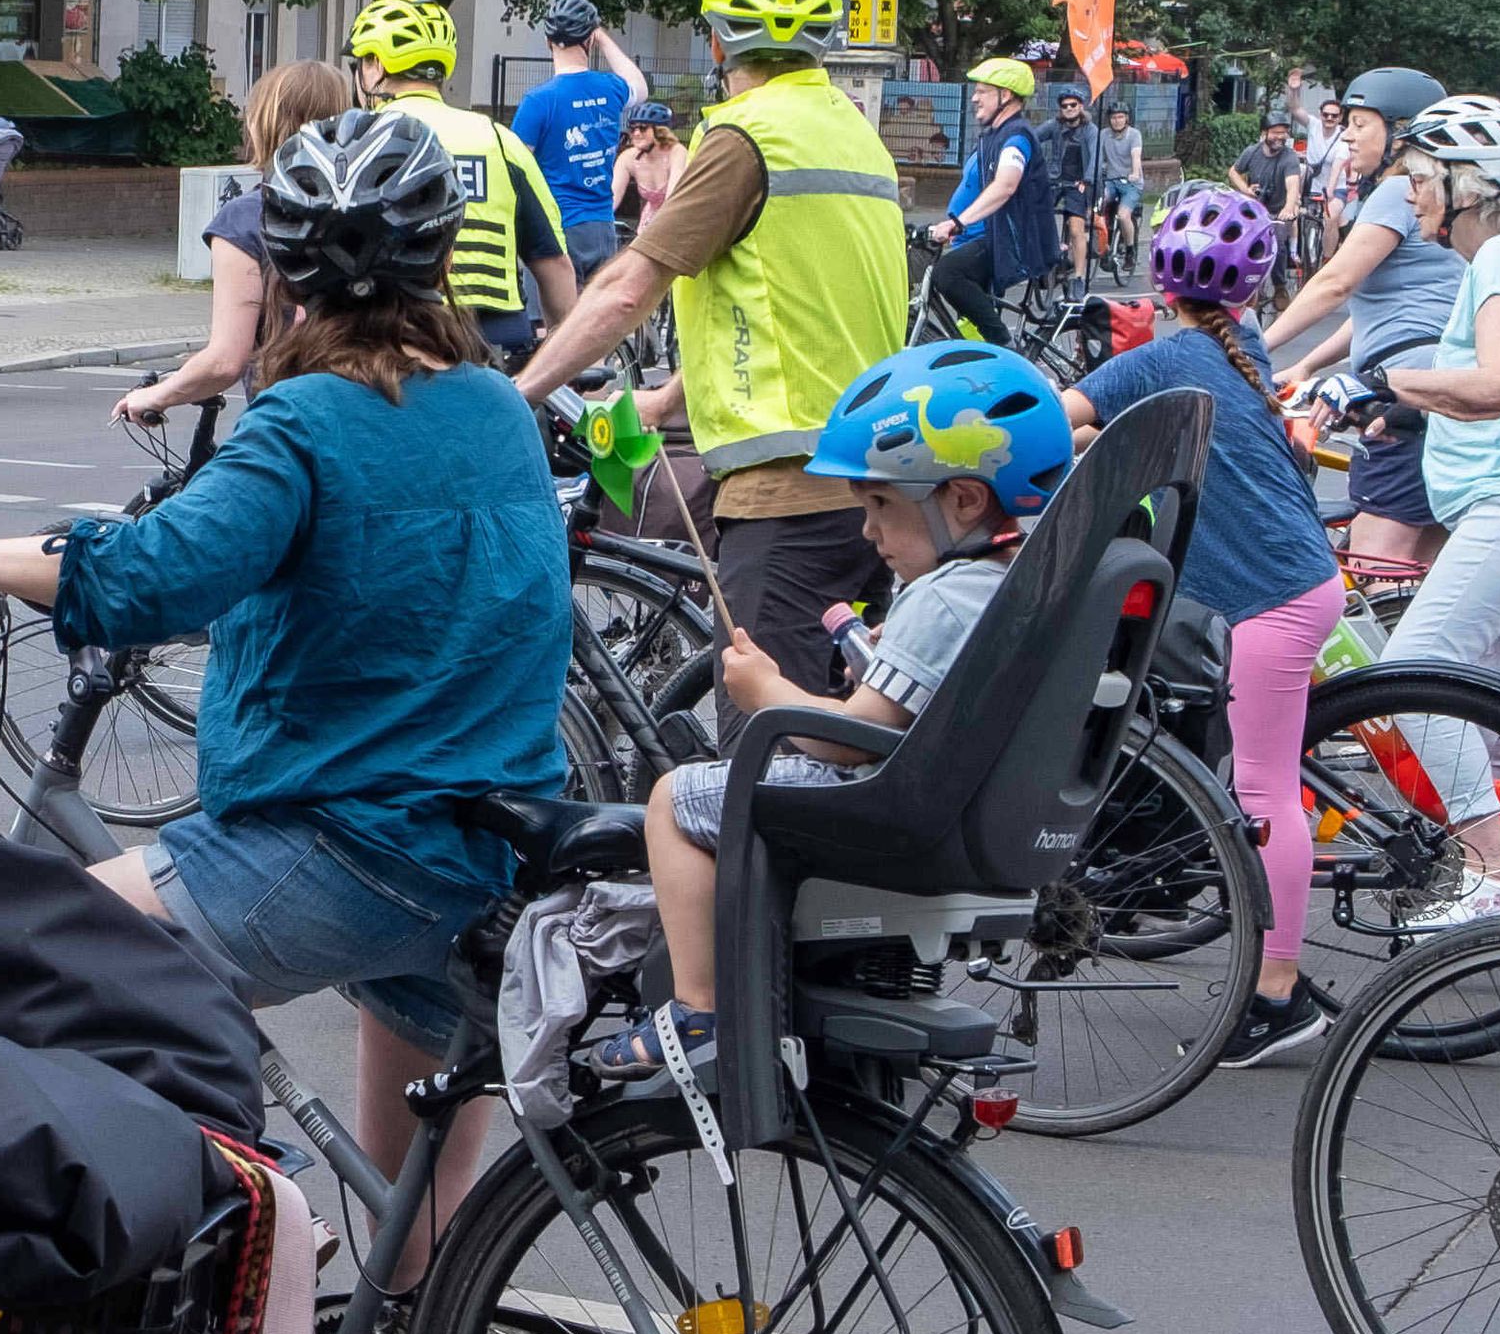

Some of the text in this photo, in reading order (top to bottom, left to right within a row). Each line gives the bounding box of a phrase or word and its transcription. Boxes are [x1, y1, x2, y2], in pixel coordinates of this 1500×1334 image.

[731, 305, 751, 399] CRAFT
[872, 411, 909, 433] uvex
[1034, 828, 1080, 850] hamax
[262, 1062, 335, 1149] MAGIC TOUR
